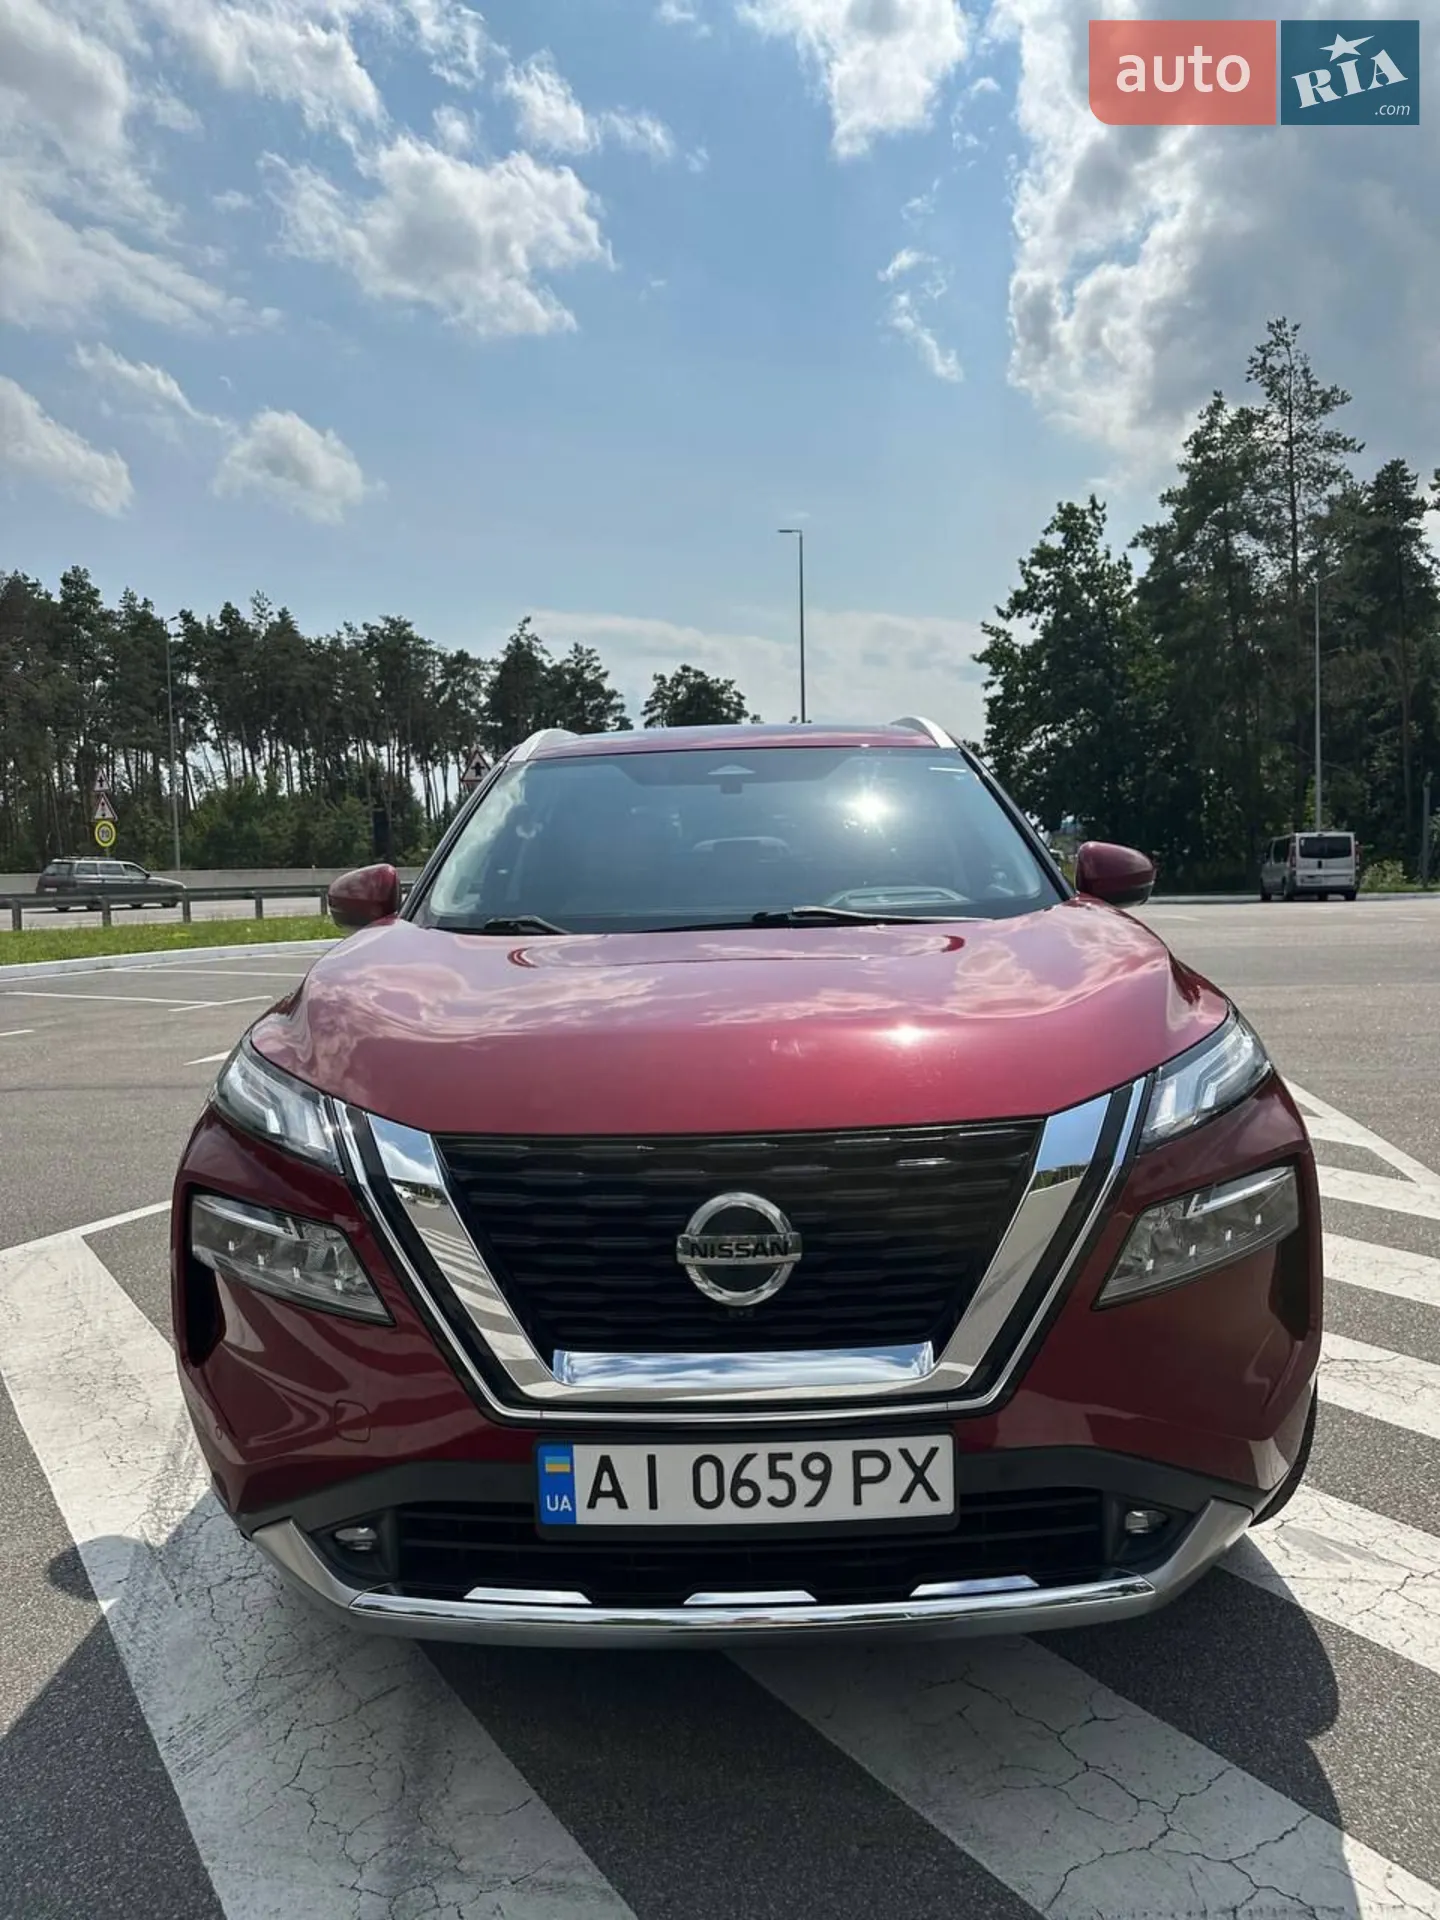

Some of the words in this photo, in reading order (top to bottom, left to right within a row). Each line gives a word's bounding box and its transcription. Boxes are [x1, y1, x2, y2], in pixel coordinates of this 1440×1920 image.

[690, 1241, 789, 1258] NISSAN
[587, 1454, 659, 1510] AI
[692, 1452, 833, 1509] 0659
[852, 1446, 941, 1506] PX
[546, 1494, 573, 1512] UA
